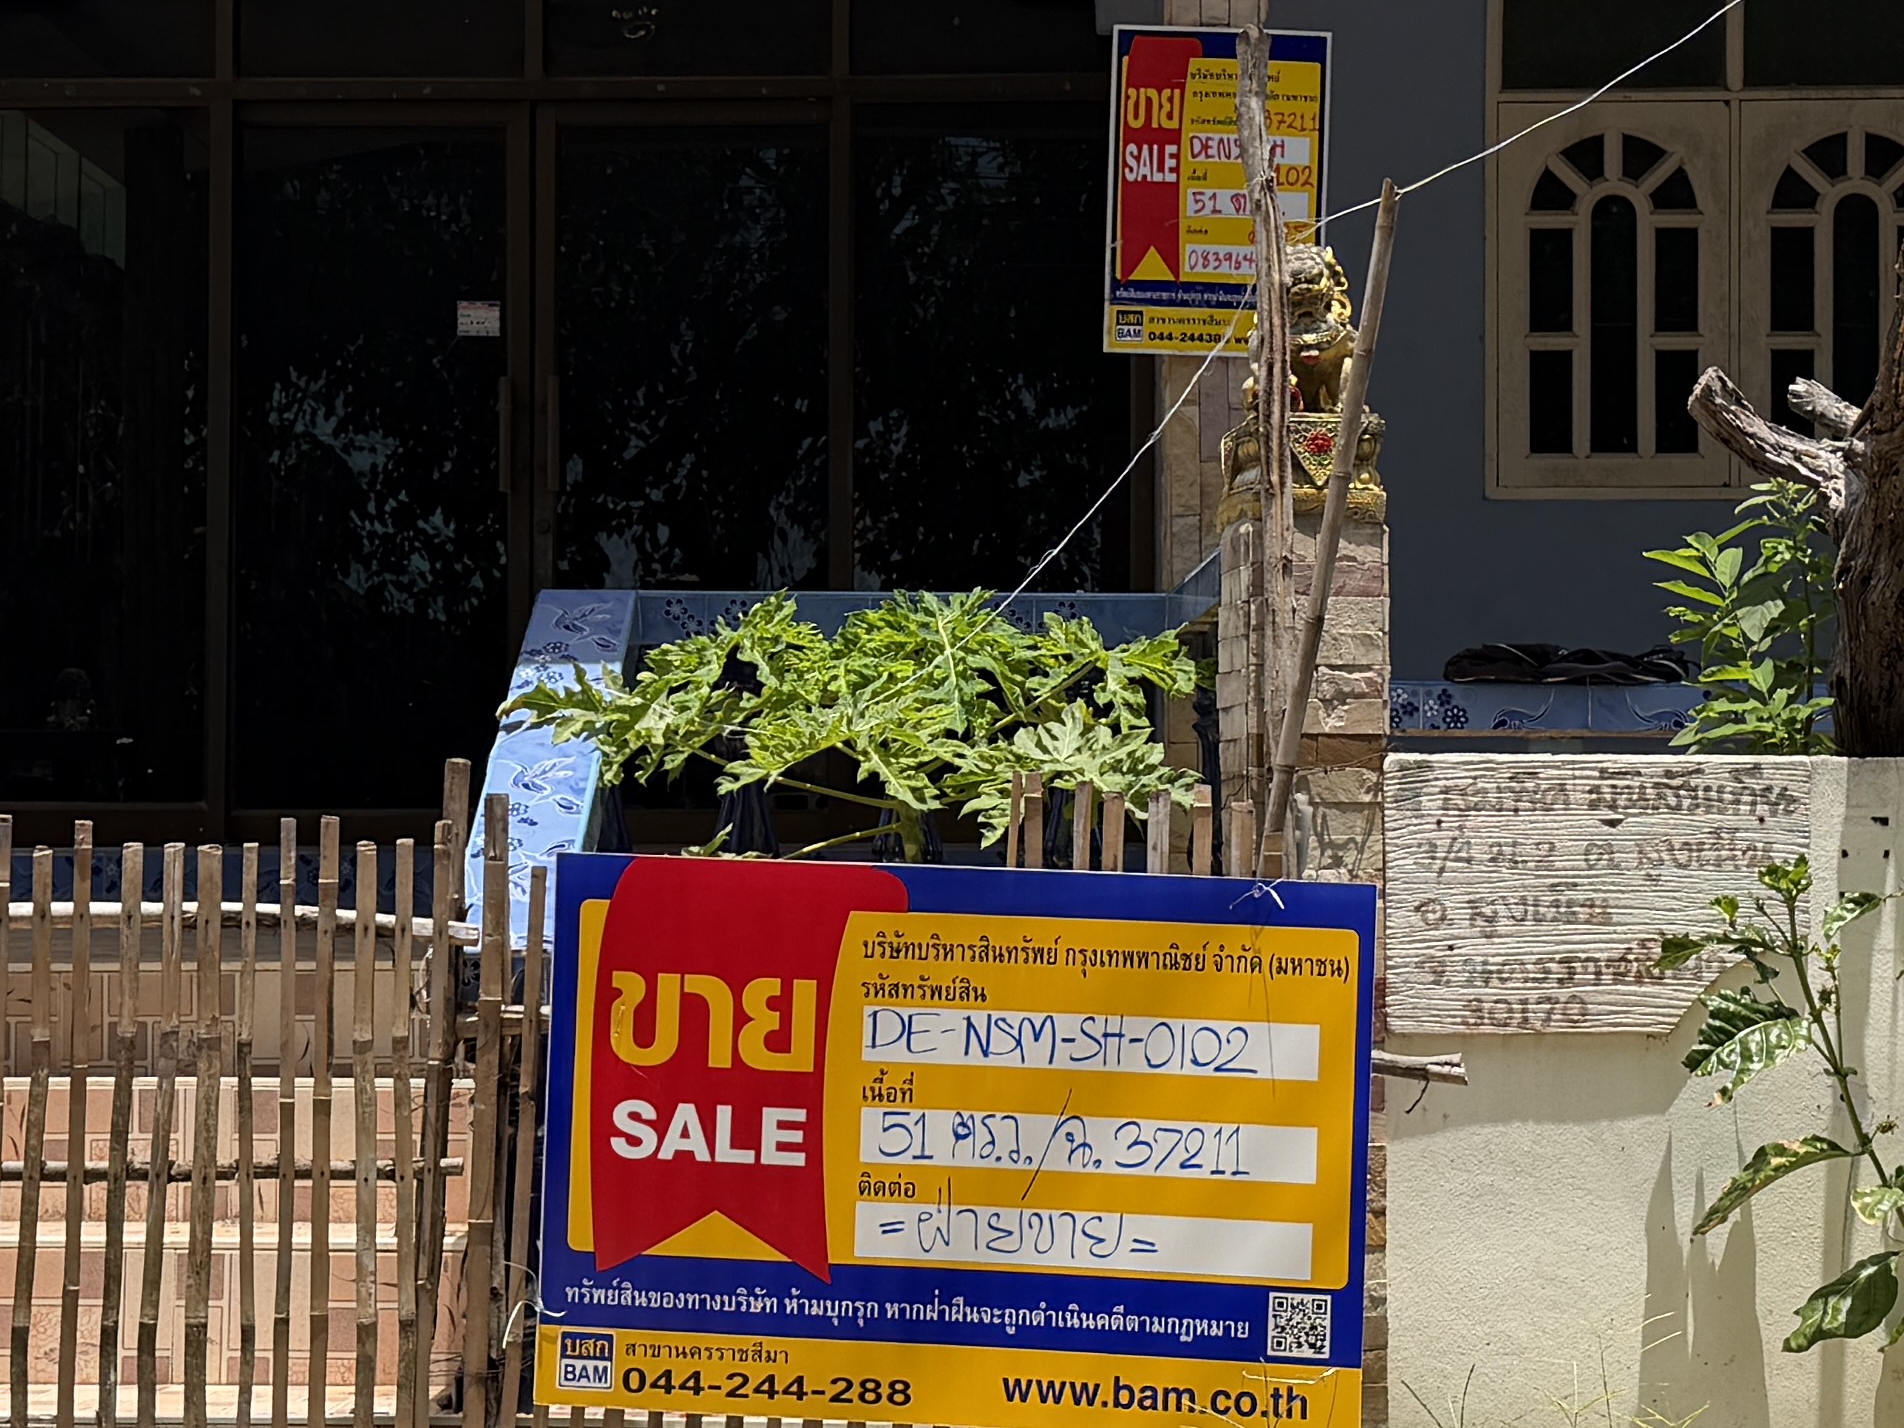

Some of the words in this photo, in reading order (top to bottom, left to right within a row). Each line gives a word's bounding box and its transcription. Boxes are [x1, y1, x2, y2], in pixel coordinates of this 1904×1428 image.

[1127, 87, 1180, 129] ขาย
[1124, 143, 1178, 182] SALE
[1188, 249, 1255, 271] 083964
[862, 931, 1059, 966] บริษัทบริหารสินทรัพย์
[1065, 942, 1208, 978] กรุงเทพพาณิชย์
[1212, 944, 1264, 974] จำกัด
[1269, 953, 1351, 983] (มหาชน)
[861, 974, 988, 1004] รหัสทรัพย์สิน
[610, 970, 817, 1073] ขาย
[865, 1007, 1258, 1074] DE-NSM-SH-0102
[861, 1069, 915, 1105] เนื้อที่
[610, 1099, 807, 1167] SALE
[878, 1110, 934, 1161] 51
[1114, 1120, 1250, 1177] 37211
[858, 1175, 917, 1200] ติดต่อ
[565, 1278, 778, 1315] ทรัพย์สินของทางบริษัท
[784, 1289, 879, 1328] ห้ามบุกรุก
[565, 1335, 610, 1359] บสก
[625, 1340, 790, 1365] สาขานครราชสีมา
[563, 1363, 609, 1384] BAM
[621, 1367, 913, 1407] 044-244-288
[1003, 1375, 1309, 1421] www.bam.co.th
